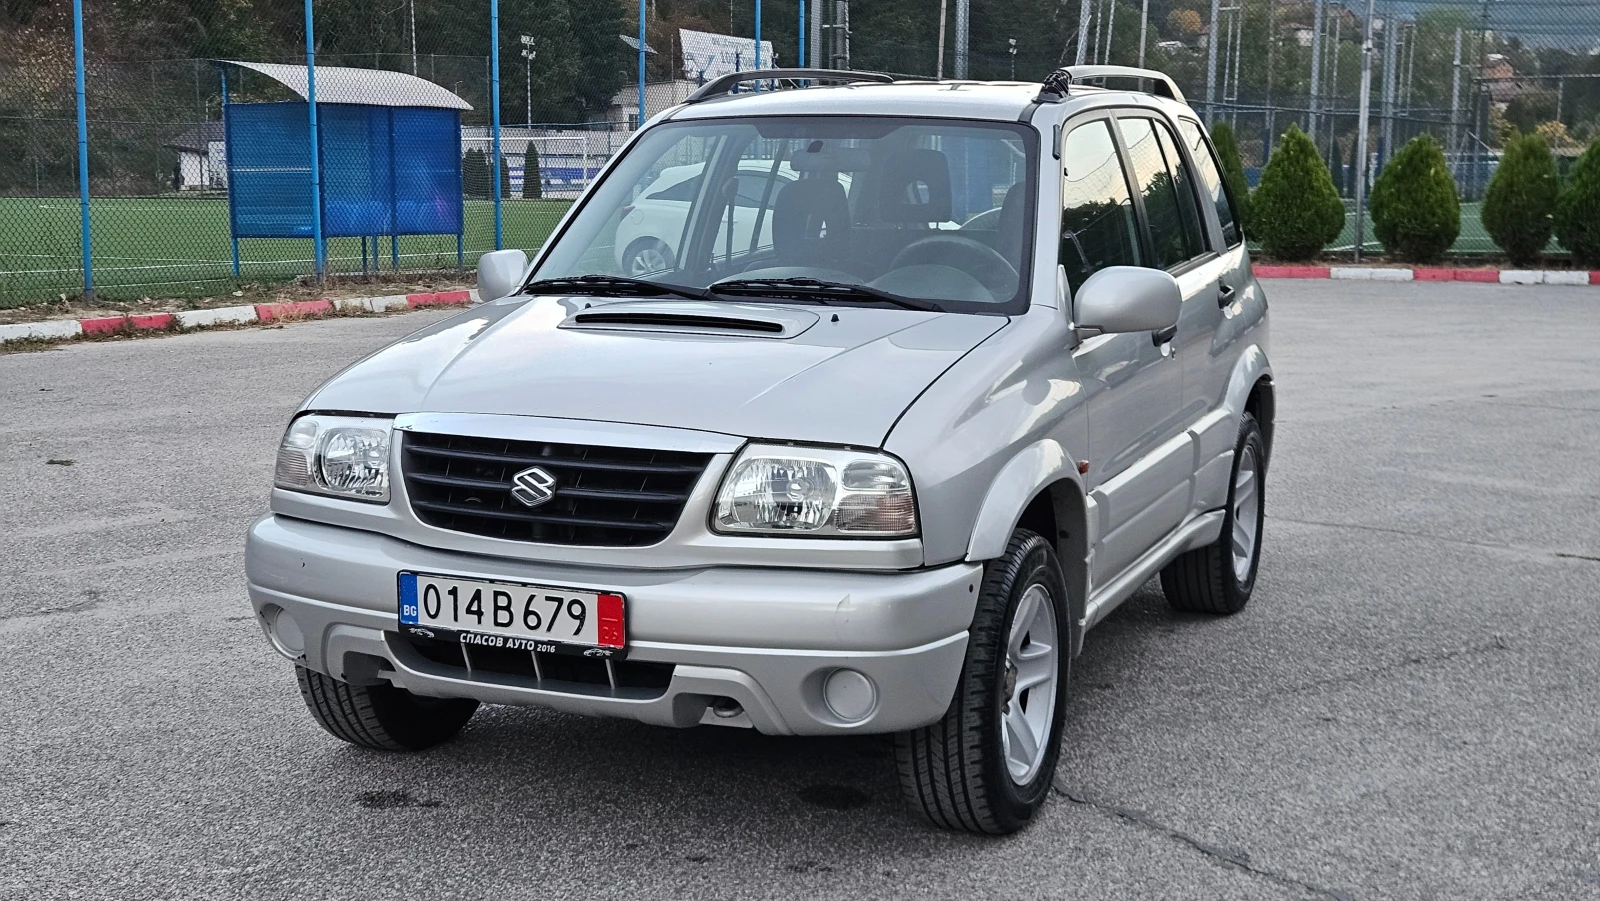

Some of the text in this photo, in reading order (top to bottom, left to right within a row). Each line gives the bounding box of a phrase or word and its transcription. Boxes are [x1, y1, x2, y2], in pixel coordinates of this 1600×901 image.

[403, 605, 417, 616] BG
[460, 632, 556, 653] СПАСОВ АУТО 2016
